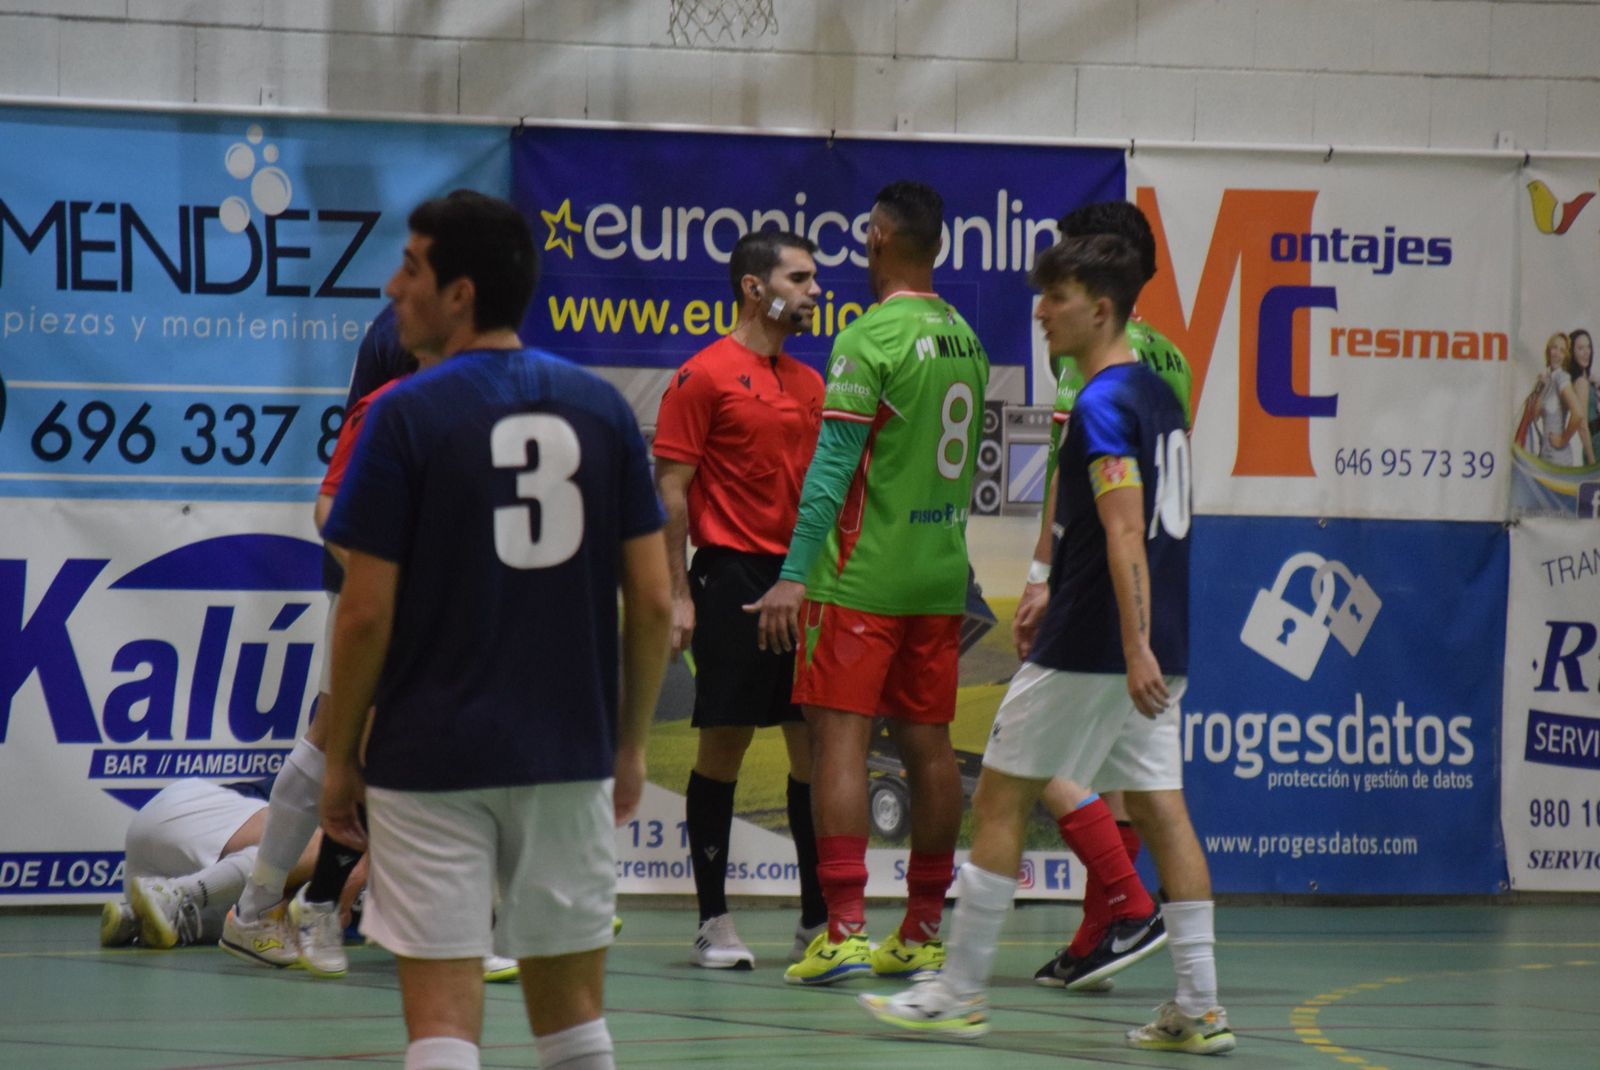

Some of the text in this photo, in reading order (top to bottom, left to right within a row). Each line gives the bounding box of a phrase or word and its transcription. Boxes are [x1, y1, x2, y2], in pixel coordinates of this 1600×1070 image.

[0, 199, 382, 298] MÉNDEZ
[3, 308, 116, 338] piezas
[131, 314, 147, 342] y
[1330, 327, 1509, 361] resman
[31, 400, 155, 463] 696
[181, 403, 300, 466] 337
[936, 382, 974, 480] 8
[1335, 447, 1495, 479] 646 95 73 39
[490, 412, 584, 570] 3
[1148, 428, 1192, 540] 10
[0, 558, 320, 745] Kalú
[1533, 620, 1600, 692] R
[1183, 692, 1475, 779] rogesdatos
[103, 754, 147, 775] BAR
[175, 753, 289, 775] HAMBURG
[1268, 768, 1474, 792] protección y gestión de datos
[1529, 799, 1571, 828] 980
[628, 820, 664, 848] 13
[1206, 831, 1418, 858] www.progesdatos.com
[0, 860, 42, 887] DE
